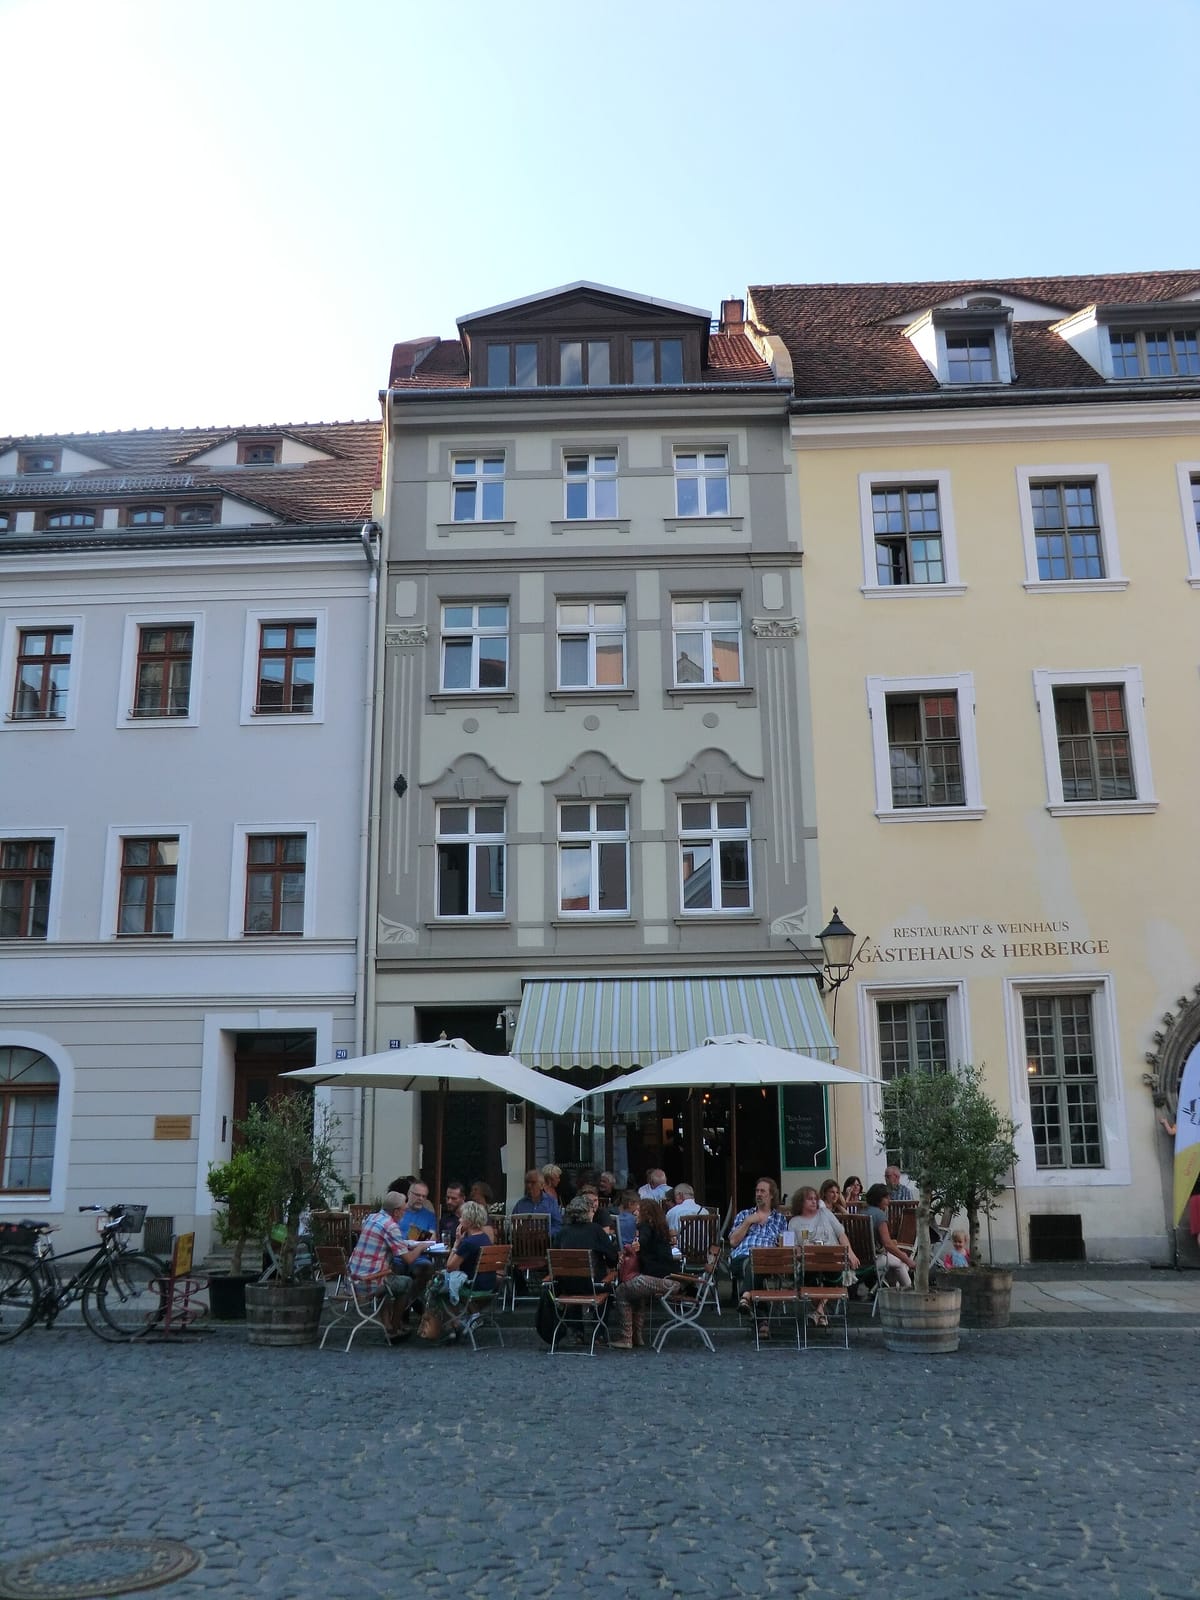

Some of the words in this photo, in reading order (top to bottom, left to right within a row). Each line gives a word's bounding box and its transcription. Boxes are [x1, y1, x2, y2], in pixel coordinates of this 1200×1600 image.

[893, 924, 979, 938] RESTAURANT
[982, 924, 993, 935] &
[997, 920, 1070, 934] WEINHAUS
[857, 944, 974, 964] GÄSTEHAUS
[980, 944, 997, 959] &
[1002, 939, 1110, 958] HERBERGE
[336, 1050, 346, 1058] 20
